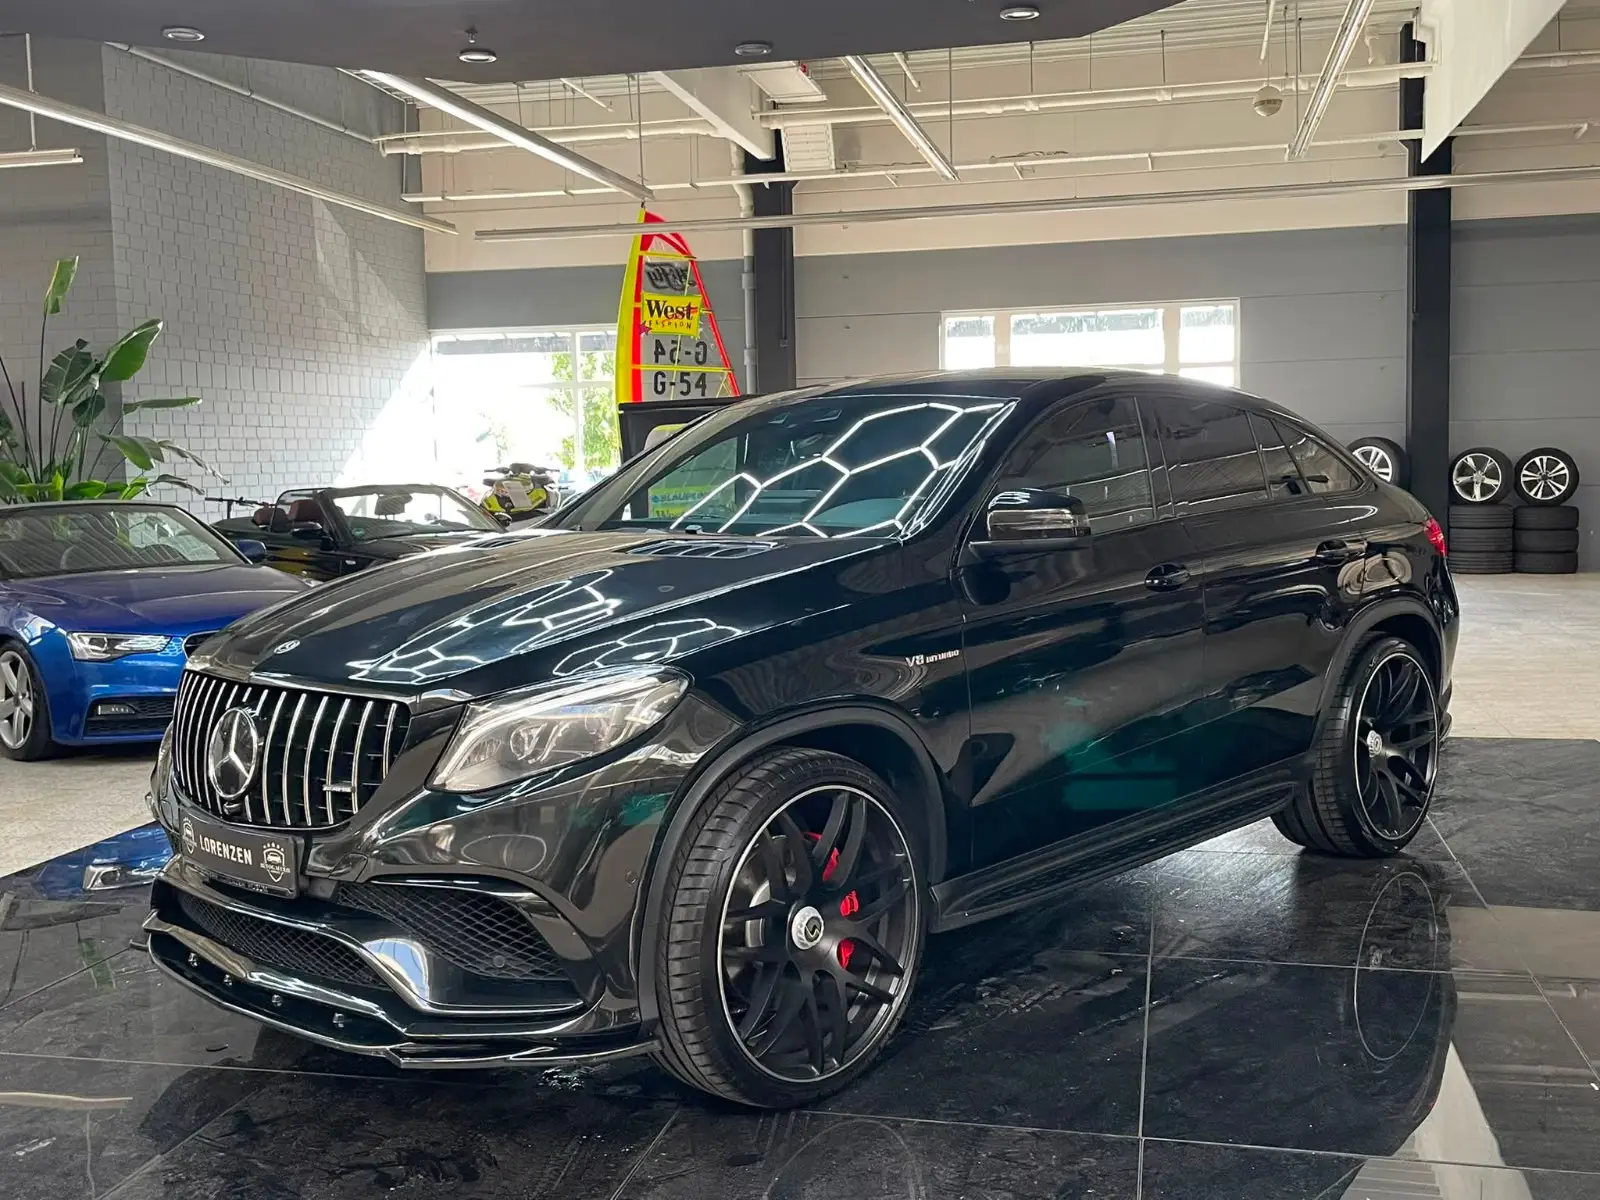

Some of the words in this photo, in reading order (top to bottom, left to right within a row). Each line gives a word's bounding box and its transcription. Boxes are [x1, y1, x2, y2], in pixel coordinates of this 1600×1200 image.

[645, 299, 693, 321] West
[649, 320, 692, 330] FASHION
[653, 371, 707, 397] G-54
[905, 654, 925, 667] V8
[199, 834, 253, 866] LORENZEN
